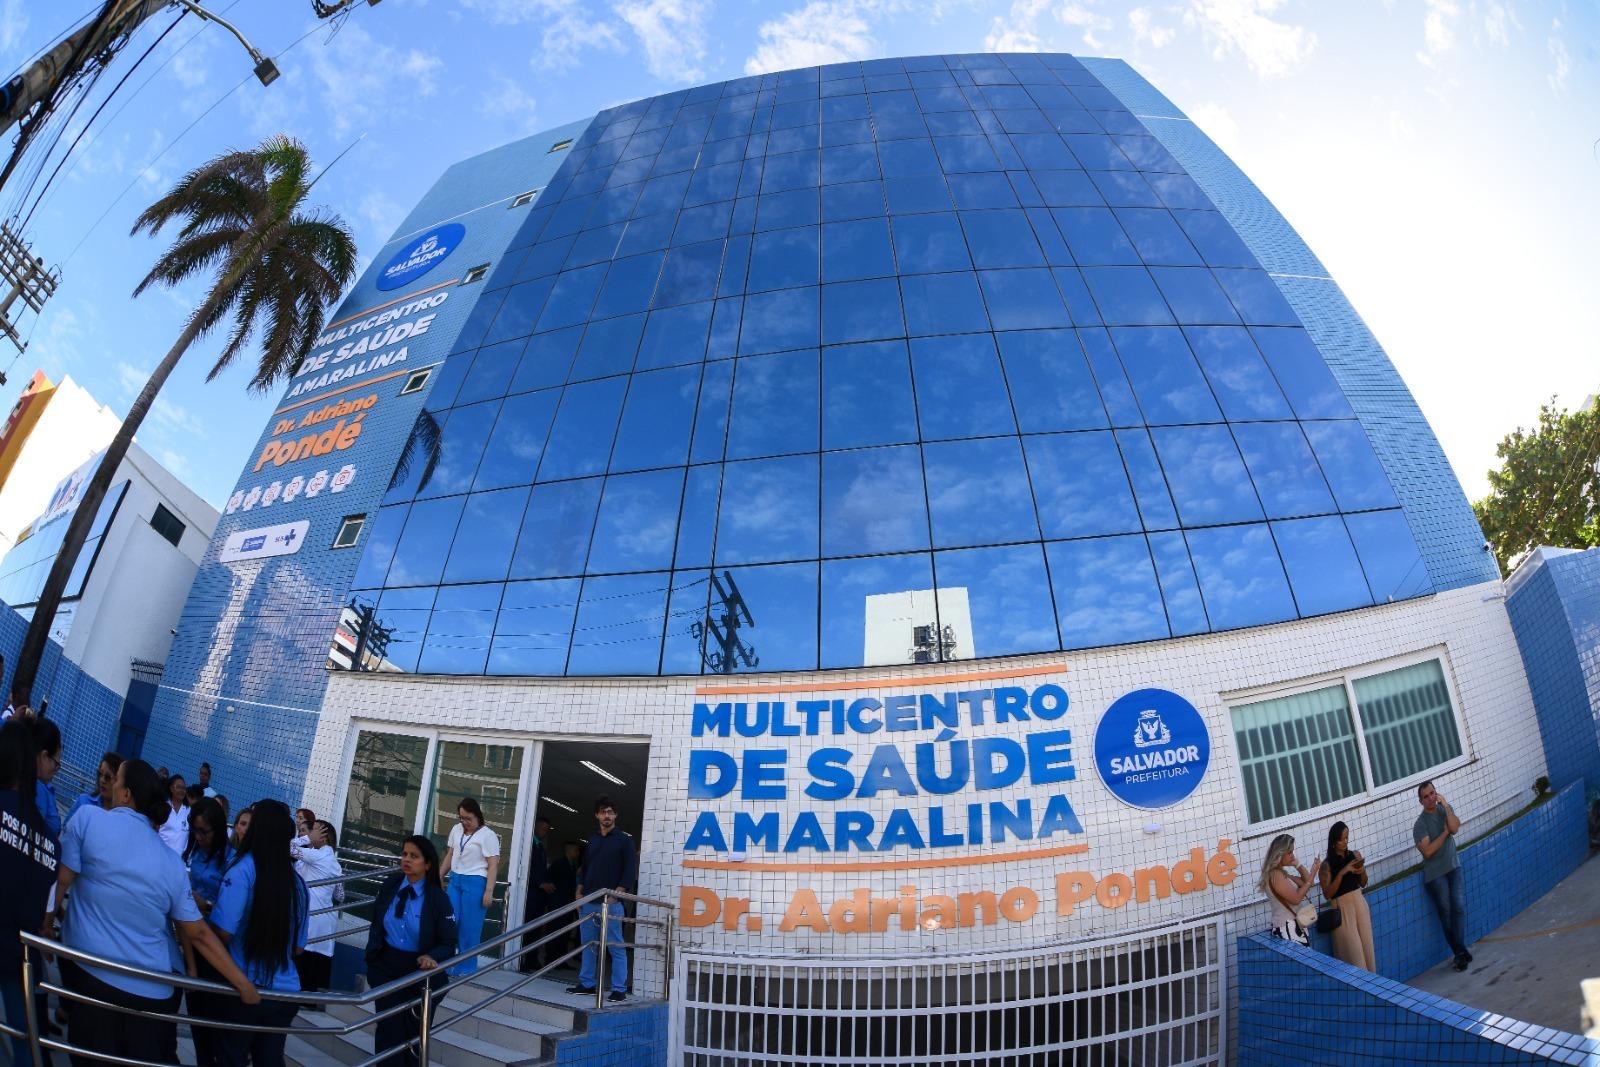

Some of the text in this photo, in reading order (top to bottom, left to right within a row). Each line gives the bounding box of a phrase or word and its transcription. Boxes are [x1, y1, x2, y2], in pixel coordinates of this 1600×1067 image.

[294, 313, 437, 378] DE SAÚDE
[312, 292, 449, 350] MULTICENTRO
[287, 347, 408, 399] AMARALINA
[252, 413, 368, 473] Pondé
[272, 393, 378, 437] Dr. Adriano
[691, 684, 1070, 738] MULTICENTRO
[687, 728, 1076, 801] DE SAÚDE
[1110, 745, 1200, 775] SALVADOR
[1125, 766, 1190, 785] PREFEITURA
[683, 793, 1084, 852] AMARALINA
[678, 838, 1238, 934] Dr. Adriano Pondé
